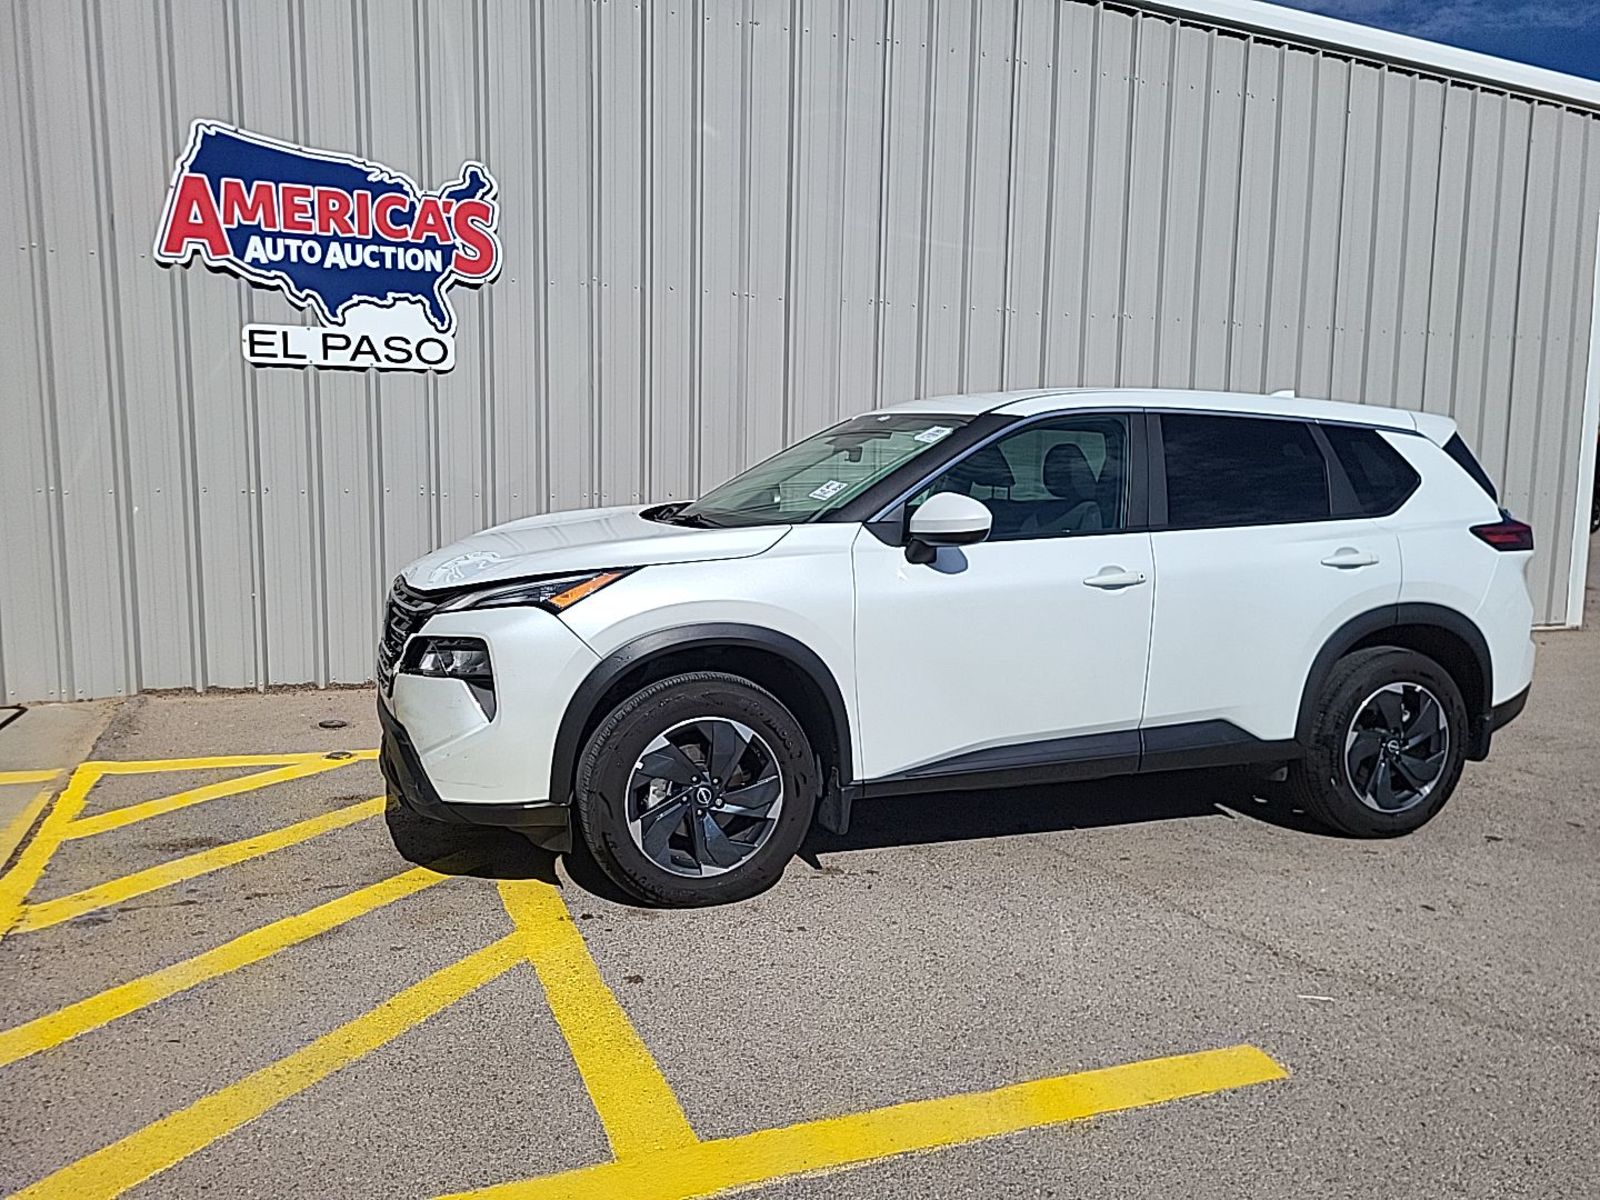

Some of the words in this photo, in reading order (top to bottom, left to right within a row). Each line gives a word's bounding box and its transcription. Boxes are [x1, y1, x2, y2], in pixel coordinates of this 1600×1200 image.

[162, 173, 496, 276] AMERICA'S
[244, 236, 322, 264] AUTO
[323, 240, 443, 272] AUCTION
[248, 329, 307, 359] EL
[321, 333, 449, 365] PASO
